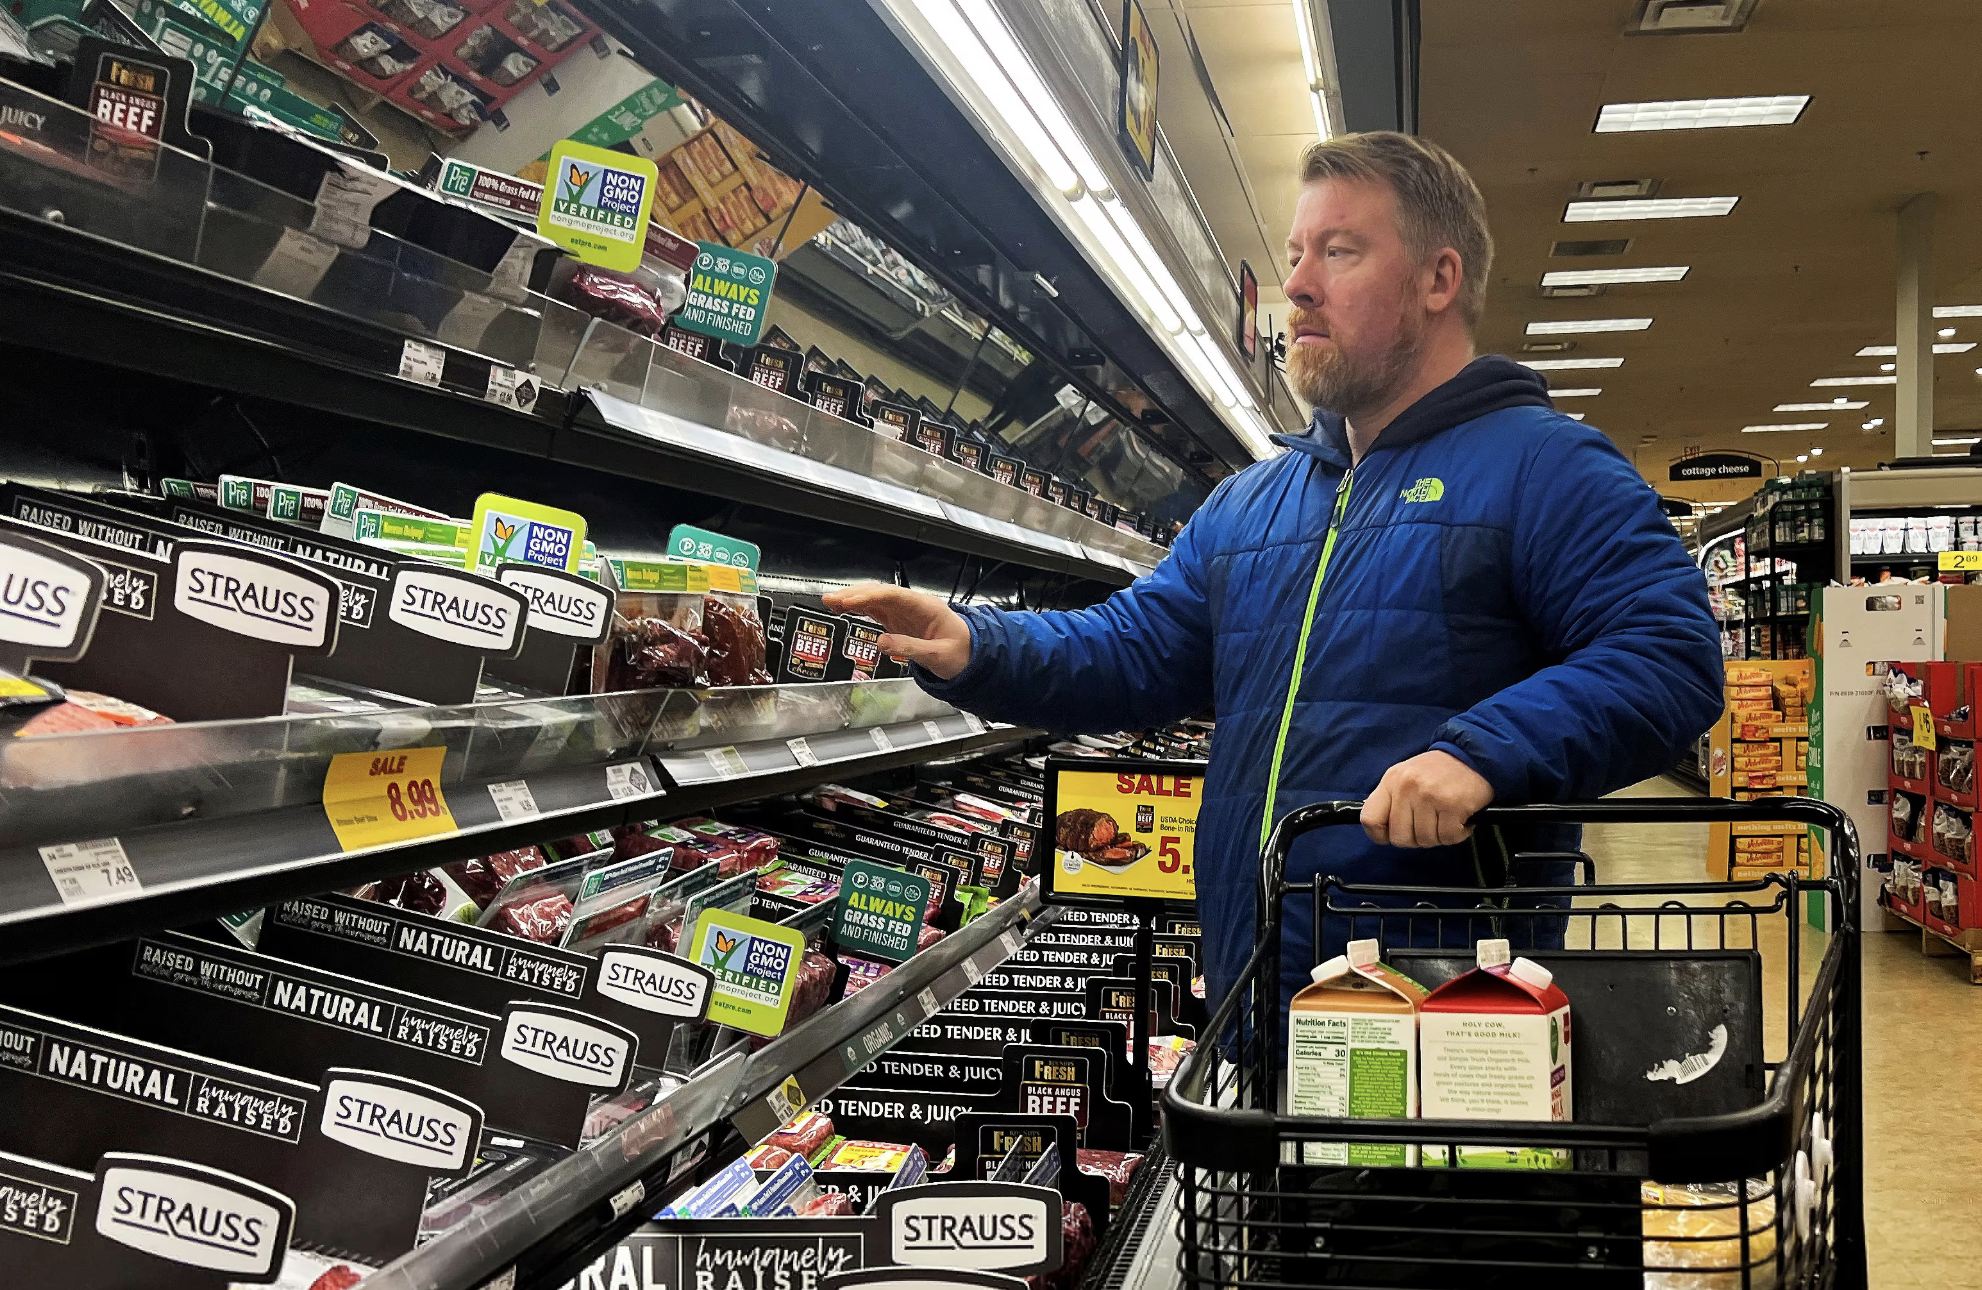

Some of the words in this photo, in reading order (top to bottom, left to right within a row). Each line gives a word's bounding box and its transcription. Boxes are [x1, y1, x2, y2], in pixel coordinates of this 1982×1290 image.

[1, 104, 47, 132] JUICY
[97, 101, 156, 134] BEEF
[478, 175, 499, 191] 100%
[499, 180, 518, 197] Grass
[606, 172, 641, 191] NON
[603, 185, 639, 204] GMO
[559, 201, 634, 229] VERIFIED
[601, 197, 637, 215] Project
[551, 214, 634, 241] nongmoproject.org
[693, 274, 760, 305] ALWAYS
[689, 291, 730, 314] GRASS
[732, 303, 756, 321] FED
[685, 307, 706, 323] AND
[707, 313, 752, 336] FINISHED
[669, 338, 703, 358] BEEF
[752, 372, 783, 390] BEEF
[816, 399, 844, 415] BEEF
[1682, 466, 1716, 477] cottage
[1718, 464, 1749, 474] cheese
[1416, 478, 1431, 486] THE
[19, 504, 73, 530] RAISED
[78, 519, 144, 551] WITHOUT
[533, 525, 569, 543] NON
[527, 549, 564, 567] Project
[530, 538, 568, 557] GMO
[189, 567, 316, 622] STRAUSS
[402, 584, 507, 629] STRAUSS
[796, 638, 827, 657] BEEF
[848, 645, 877, 660] BEEF
[369, 756, 408, 777] SALE
[999, 785, 1033, 800] GUARANTEED
[1116, 773, 1193, 798] SALE
[387, 779, 441, 822] 8.99
[1160, 816, 1178, 824] USDA
[894, 821, 935, 837] GUARANTEED
[937, 833, 962, 843] TENDER
[855, 834, 900, 851] GUARANTEED
[902, 846, 929, 860] TENDER
[101, 866, 135, 887] 7.49
[848, 891, 916, 922] ALWAYS
[284, 900, 329, 920] RAISED
[334, 910, 390, 935] WITHOUT
[844, 909, 886, 930] GRASS
[887, 919, 912, 937] FED
[1090, 912, 1131, 924] TENDER
[840, 923, 861, 939] AND
[862, 929, 908, 951] FINISHED
[1058, 934, 1101, 946] TENDER
[1104, 936, 1113, 946] &
[400, 927, 495, 971] NATURAL
[753, 940, 787, 959] NON
[1042, 952, 1088, 964] TENDER
[1091, 954, 1100, 965] &
[1155, 944, 1186, 957] FRESH
[143, 945, 194, 972] RAISED
[200, 960, 264, 990] WITHOUT
[510, 950, 581, 981] humanely
[747, 963, 781, 980] Project
[750, 953, 784, 970] GMO
[506, 965, 576, 992] RAISED
[608, 963, 697, 1001] STRAUSS
[1018, 975, 1062, 988] TENDER
[1064, 977, 1075, 989] &
[273, 980, 383, 1033] NATURAL
[984, 1000, 1037, 1014] TENDER
[1039, 1001, 1050, 1014] &
[1106, 1012, 1127, 1020] BLACK
[400, 1009, 483, 1045] humanely
[944, 1025, 1002, 1041] TENDER
[1006, 1028, 1019, 1042] &
[1296, 1018, 1326, 1027] Nutrition
[1328, 1020, 1346, 1028] Facts
[397, 1025, 477, 1058] RAISED
[514, 1024, 620, 1068] STRAUSS
[862, 1022, 894, 1055] ORGANIC
[1061, 1031, 1099, 1047] FRESH
[1334, 1049, 1346, 1058] 30
[49, 1043, 179, 1105] NATURAL
[882, 1061, 944, 1078] TENDER
[948, 1064, 961, 1079] &
[963, 1066, 1002, 1083] JUICY
[1034, 1060, 1076, 1081] FRESH
[200, 1077, 297, 1120] humanely
[1028, 1086, 1052, 1095] BLACK
[1055, 1088, 1081, 1097] ANGUS
[838, 1100, 905, 1120] TENDER
[909, 1105, 923, 1121] &
[1027, 1096, 1080, 1114] BEEF
[196, 1097, 291, 1135] RAISED
[336, 1095, 457, 1147] STRAUSS
[847, 1185, 861, 1203] &
[114, 1186, 263, 1247] STRAUSS
[904, 1213, 1035, 1245] STRAUSS
[696, 1237, 854, 1275] humanely
[696, 1270, 818, 1290] RAISE
